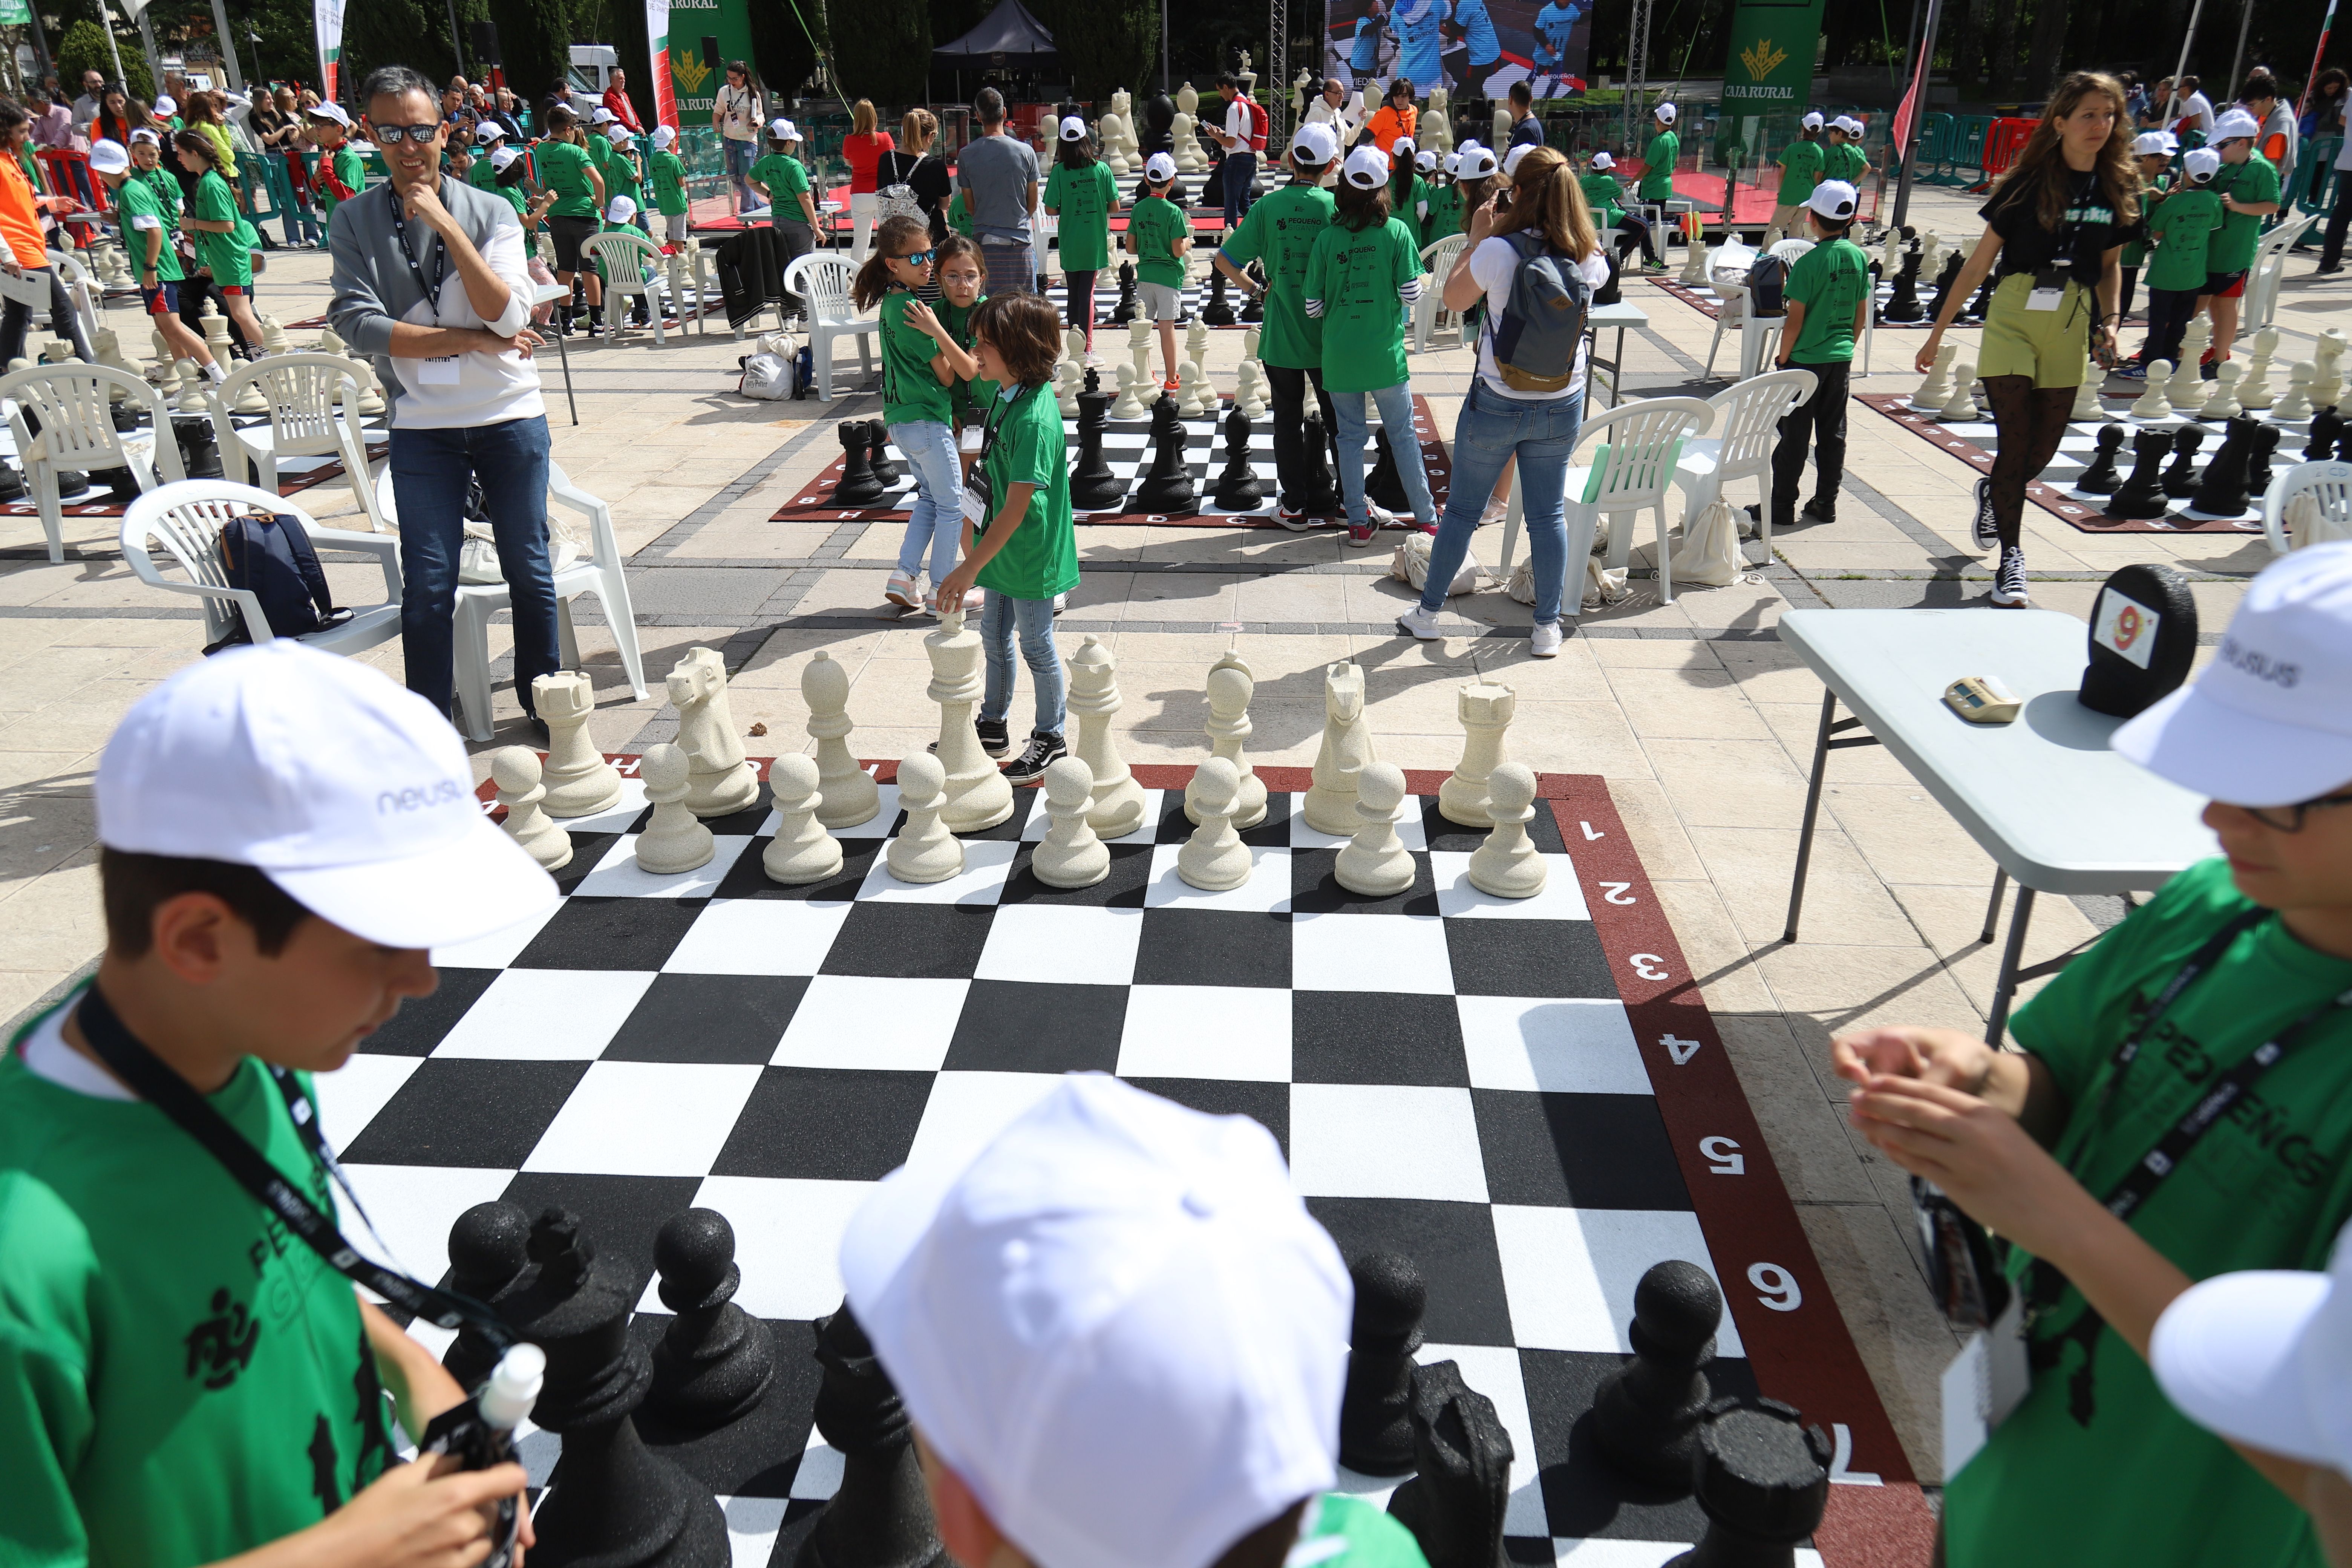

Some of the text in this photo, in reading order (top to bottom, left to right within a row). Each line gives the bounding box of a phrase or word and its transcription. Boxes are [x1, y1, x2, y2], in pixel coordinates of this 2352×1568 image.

[657, 4, 669, 15] ZAMOR
[675, 0, 718, 9] RURAL
[319, 13, 327, 22] DE
[1414, 29, 1435, 40] OVIEDO
[1725, 86, 1794, 99] CAJA RURAL
[688, 98, 714, 110] RUR
[1349, 253, 1375, 262] GGANTE
[1017, 386, 1026, 398] SIGNUS
[10, 505, 37, 514] C
[79, 505, 110, 514] B
[2057, 505, 2084, 514] 8
[2114, 605, 2139, 651] 9
[1579, 821, 1605, 841] 1
[1598, 881, 1636, 905] 2
[1629, 952, 1669, 981] 3
[1658, 1033, 1700, 1066] 4
[2154, 1020, 2333, 1188] PEQEÑOS
[1699, 1136, 1745, 1176] 5
[1747, 1262, 1803, 1312] 6
[1829, 1423, 1883, 1487] 7
